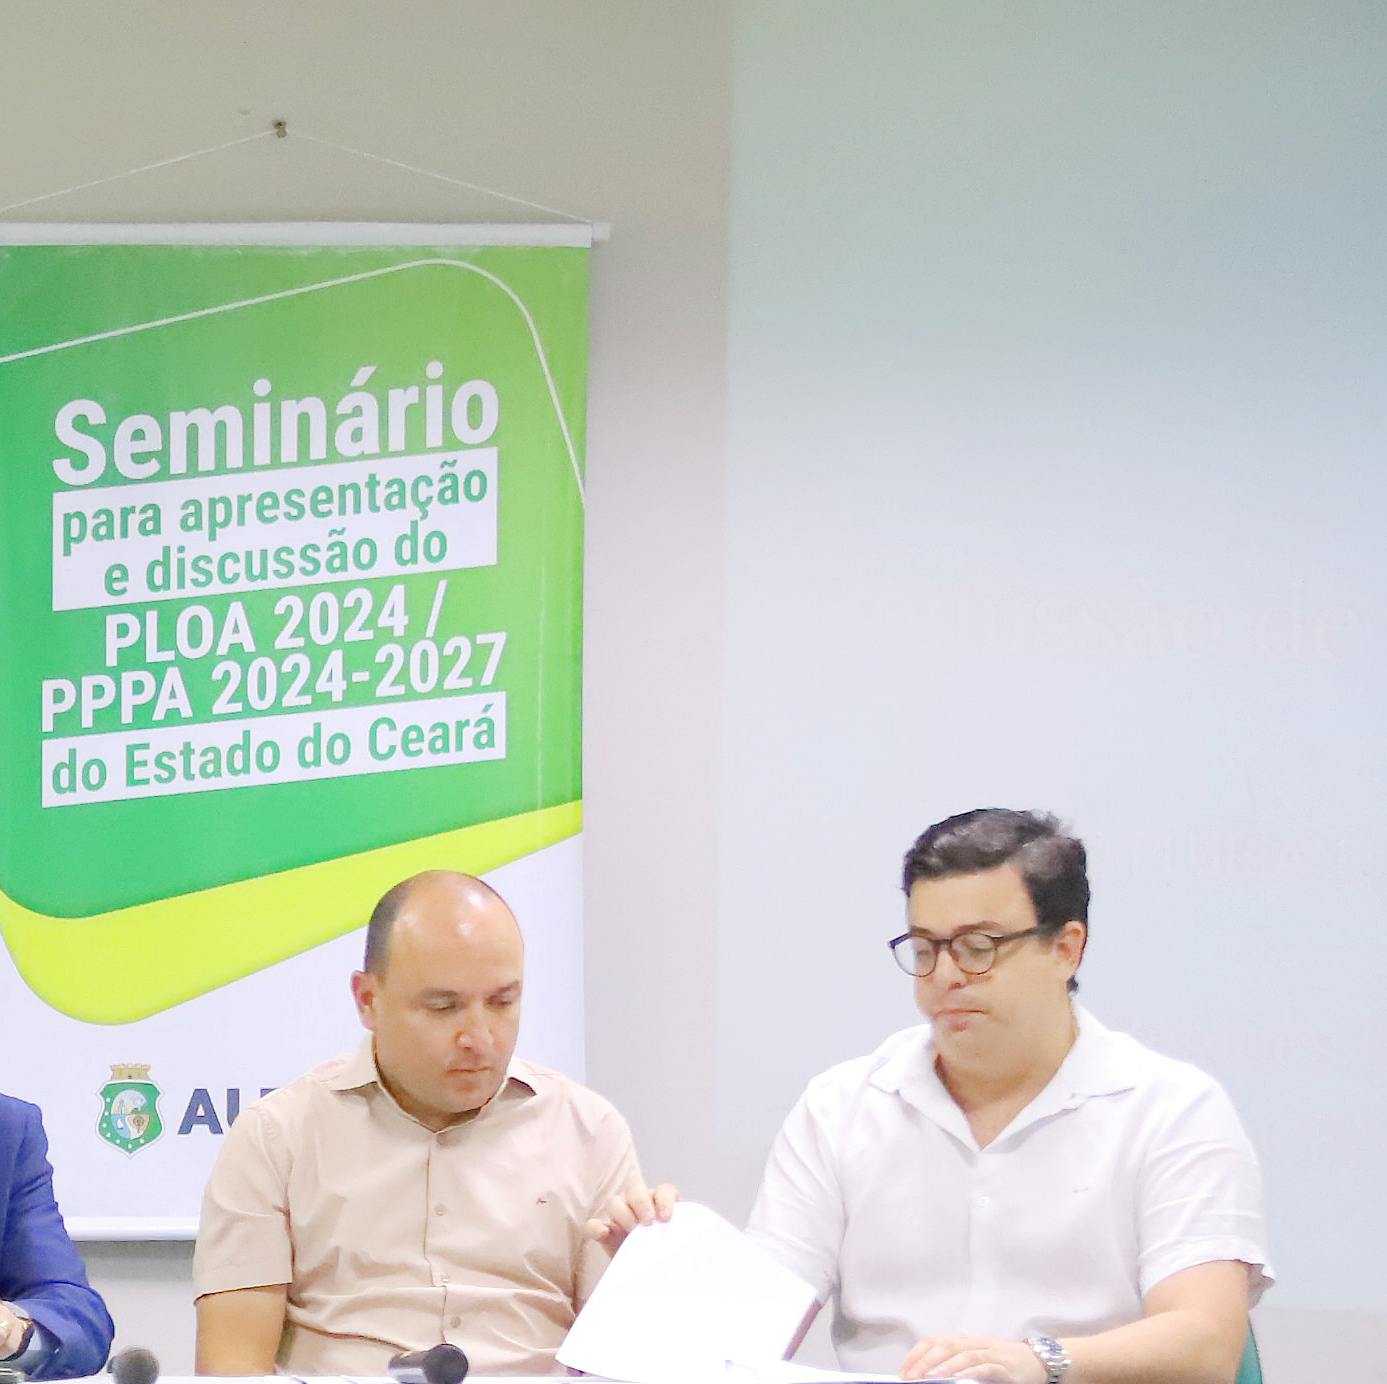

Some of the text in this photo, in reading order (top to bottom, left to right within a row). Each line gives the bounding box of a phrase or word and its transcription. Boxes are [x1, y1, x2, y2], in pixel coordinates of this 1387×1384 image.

[52, 360, 500, 486] Seminário
[62, 460, 488, 555] para apresentação
[104, 519, 448, 597] e discussão do
[105, 579, 448, 667] PLOA 2024 /
[41, 630, 507, 732] PPPA 2024-2027
[51, 704, 496, 794] do Estado do Ceará
